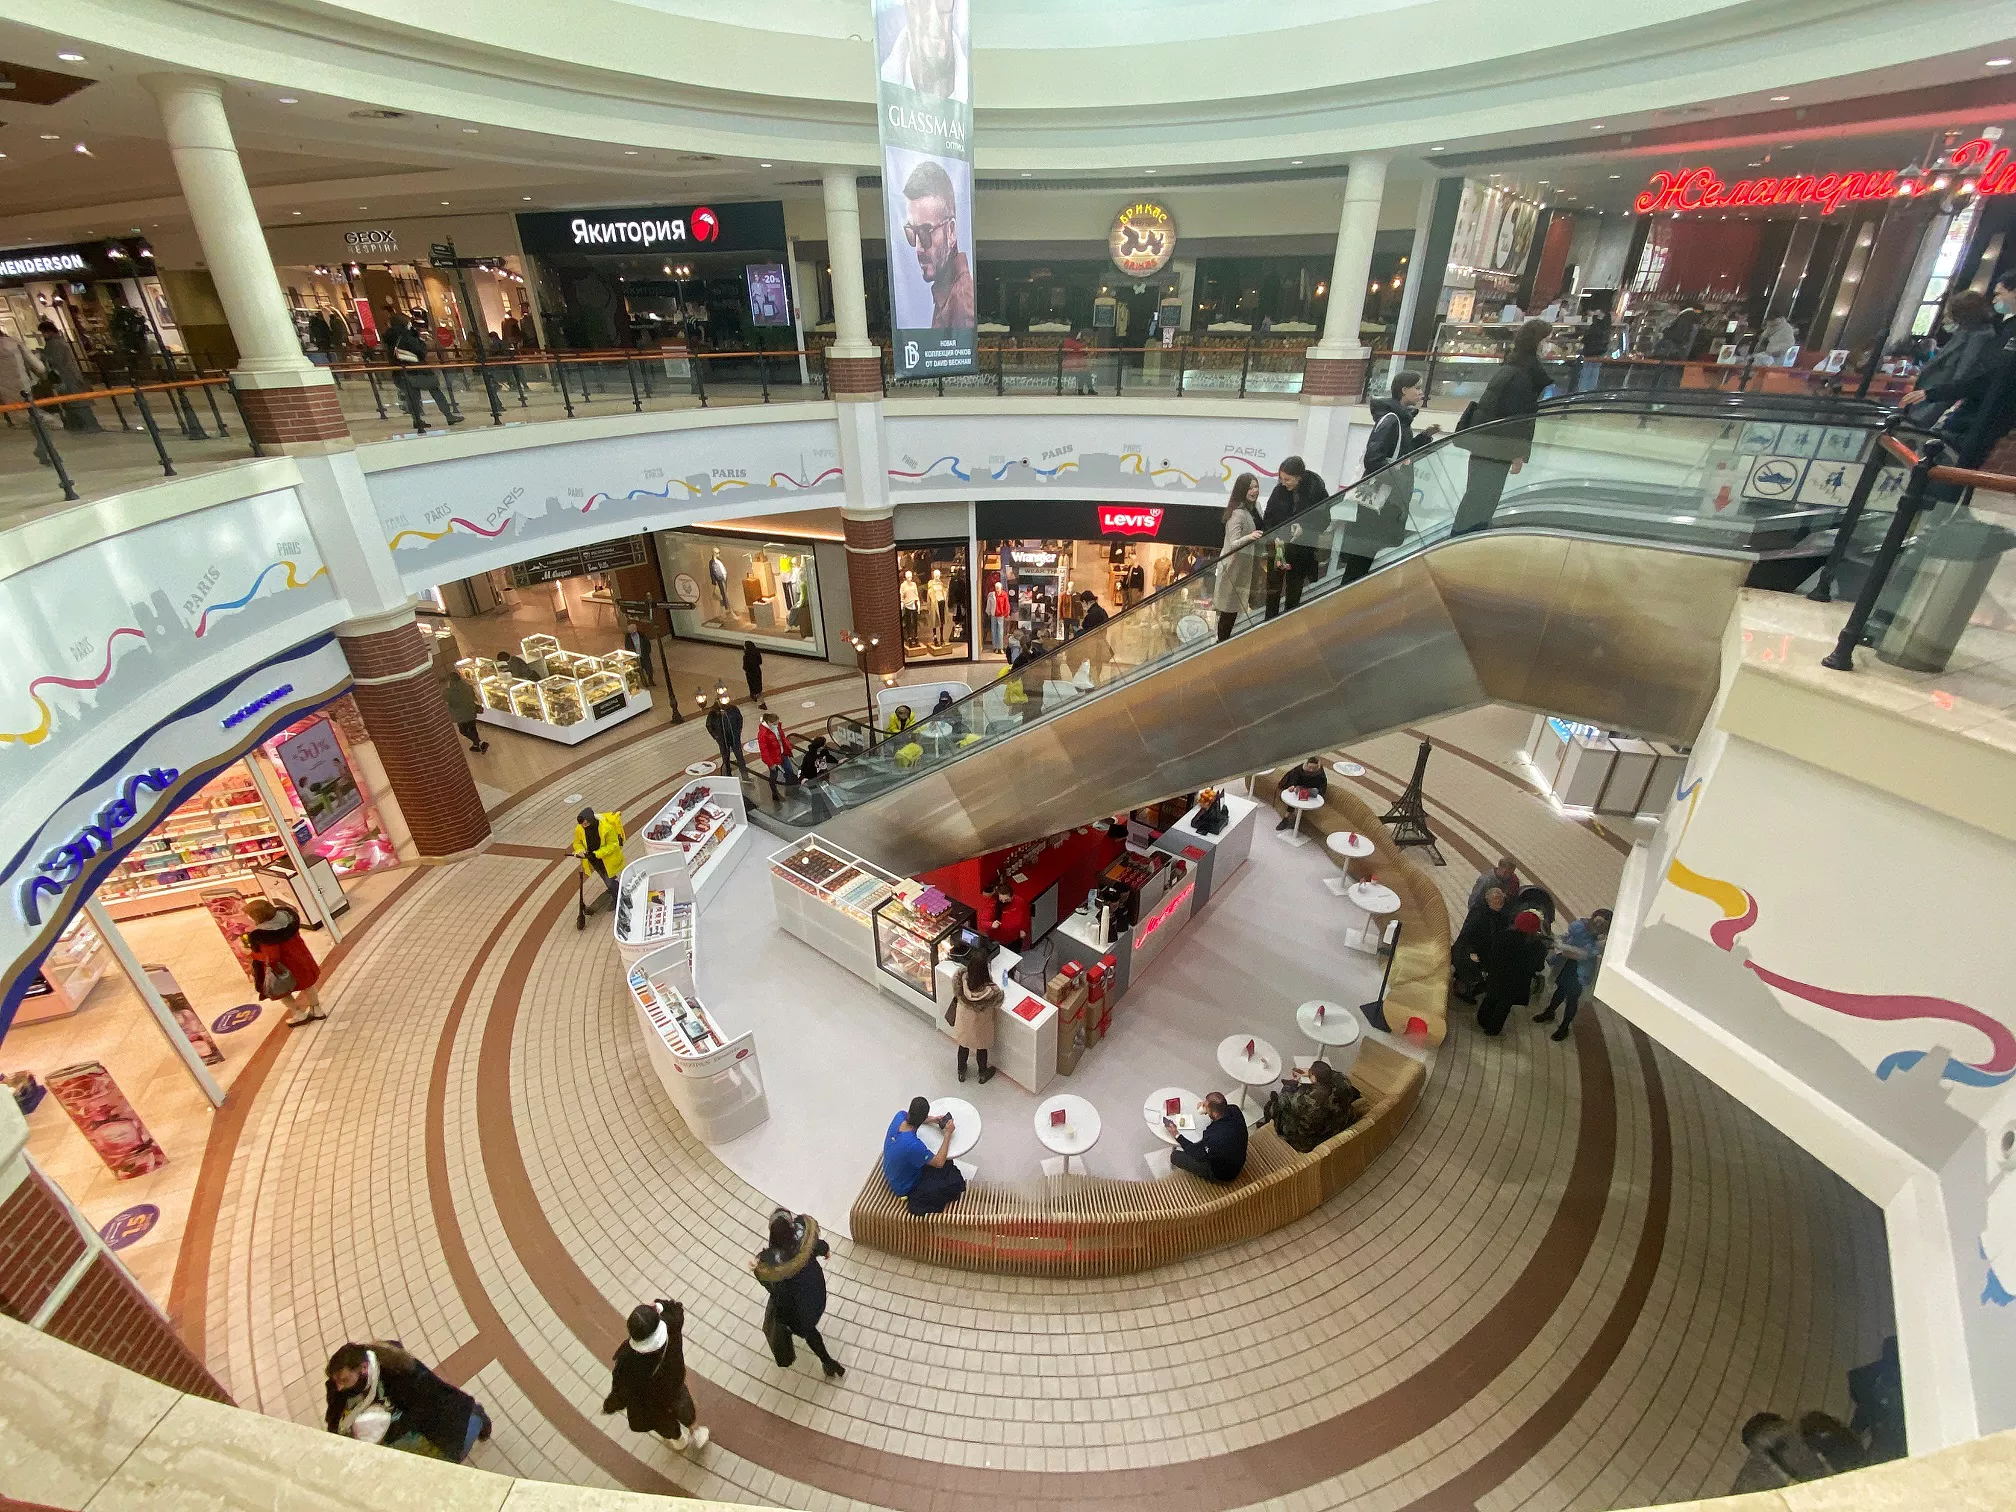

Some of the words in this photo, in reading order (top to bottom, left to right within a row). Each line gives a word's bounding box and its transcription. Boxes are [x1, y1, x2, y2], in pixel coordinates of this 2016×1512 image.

[888, 104, 965, 142] GLASSMAN
[344, 230, 396, 245] GEOX
[571, 218, 686, 247] Якитория
[0, 254, 84, 276] HENDERSON
[940, 339, 957, 347] НОВАЯ
[933, 359, 948, 367] DAVID
[1041, 444, 1075, 461] PARIS
[1223, 445, 1267, 459] PARIS
[712, 468, 748, 478] PARIS
[424, 502, 453, 525] PARIS
[486, 485, 525, 527] PARIS
[277, 541, 302, 556] PARIS
[1011, 551, 1057, 567] Wrangler
[182, 565, 222, 615] PARIS
